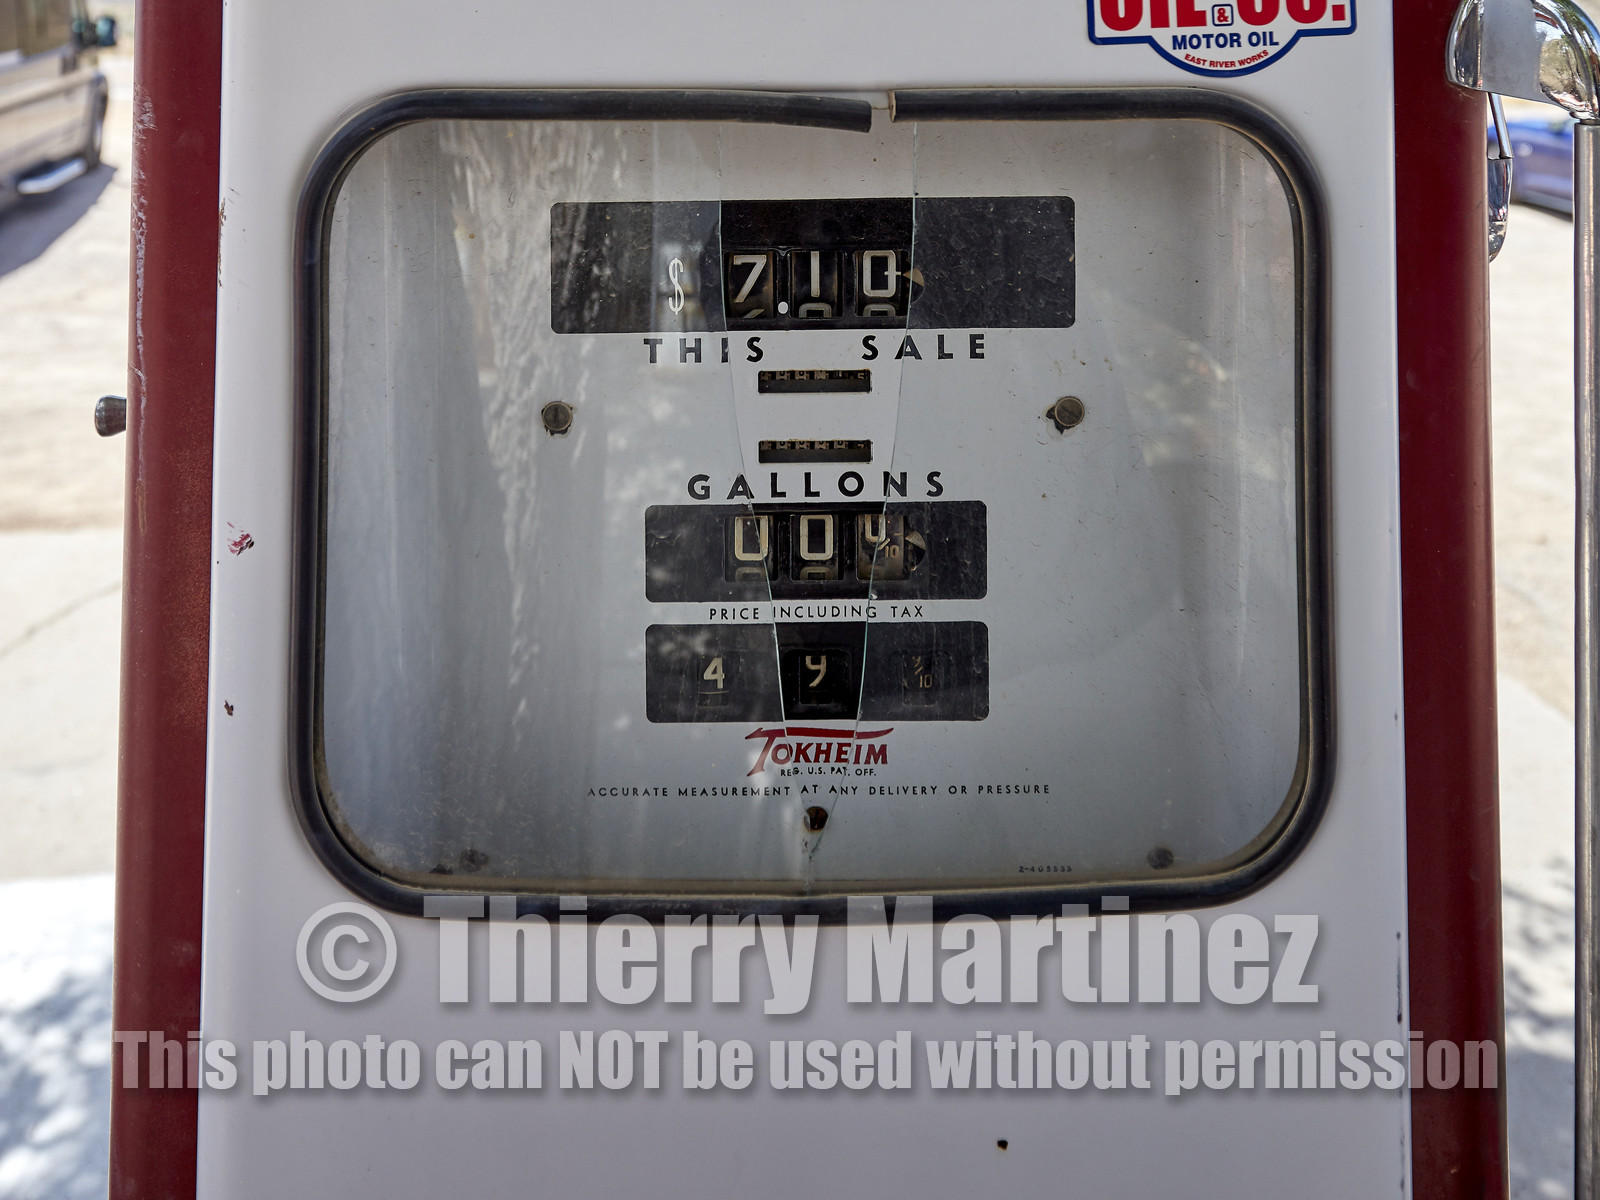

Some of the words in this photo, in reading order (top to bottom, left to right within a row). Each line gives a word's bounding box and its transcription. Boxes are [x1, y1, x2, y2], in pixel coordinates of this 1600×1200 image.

[1216, 7, 1229, 23] &
[1172, 33, 1242, 50] MOTOR
[1248, 31, 1280, 47] OIL
[1184, 53, 1207, 67] EAST
[1209, 60, 1236, 68] RIVER
[1238, 49, 1269, 67] WORKS
[643, 336, 764, 364] THIS
[861, 333, 986, 361] SALE
[687, 471, 944, 500] GALLONS
[709, 607, 760, 620] PRICE
[773, 605, 877, 619] INCLUDING
[891, 606, 923, 618] TAX
[745, 727, 894, 777] TOKHEIM
[807, 766, 826, 775] U.S.
[830, 766, 850, 777] PAT.
[855, 768, 877, 777] OFF.
[587, 787, 668, 797] ACCURATE
[678, 786, 791, 797] MEASUREMENT
[801, 785, 818, 794] AT
[829, 785, 858, 795] ANY
[869, 786, 938, 795] DELIVERY
[948, 785, 968, 795] OR
[978, 785, 1050, 794] PRESSURE
